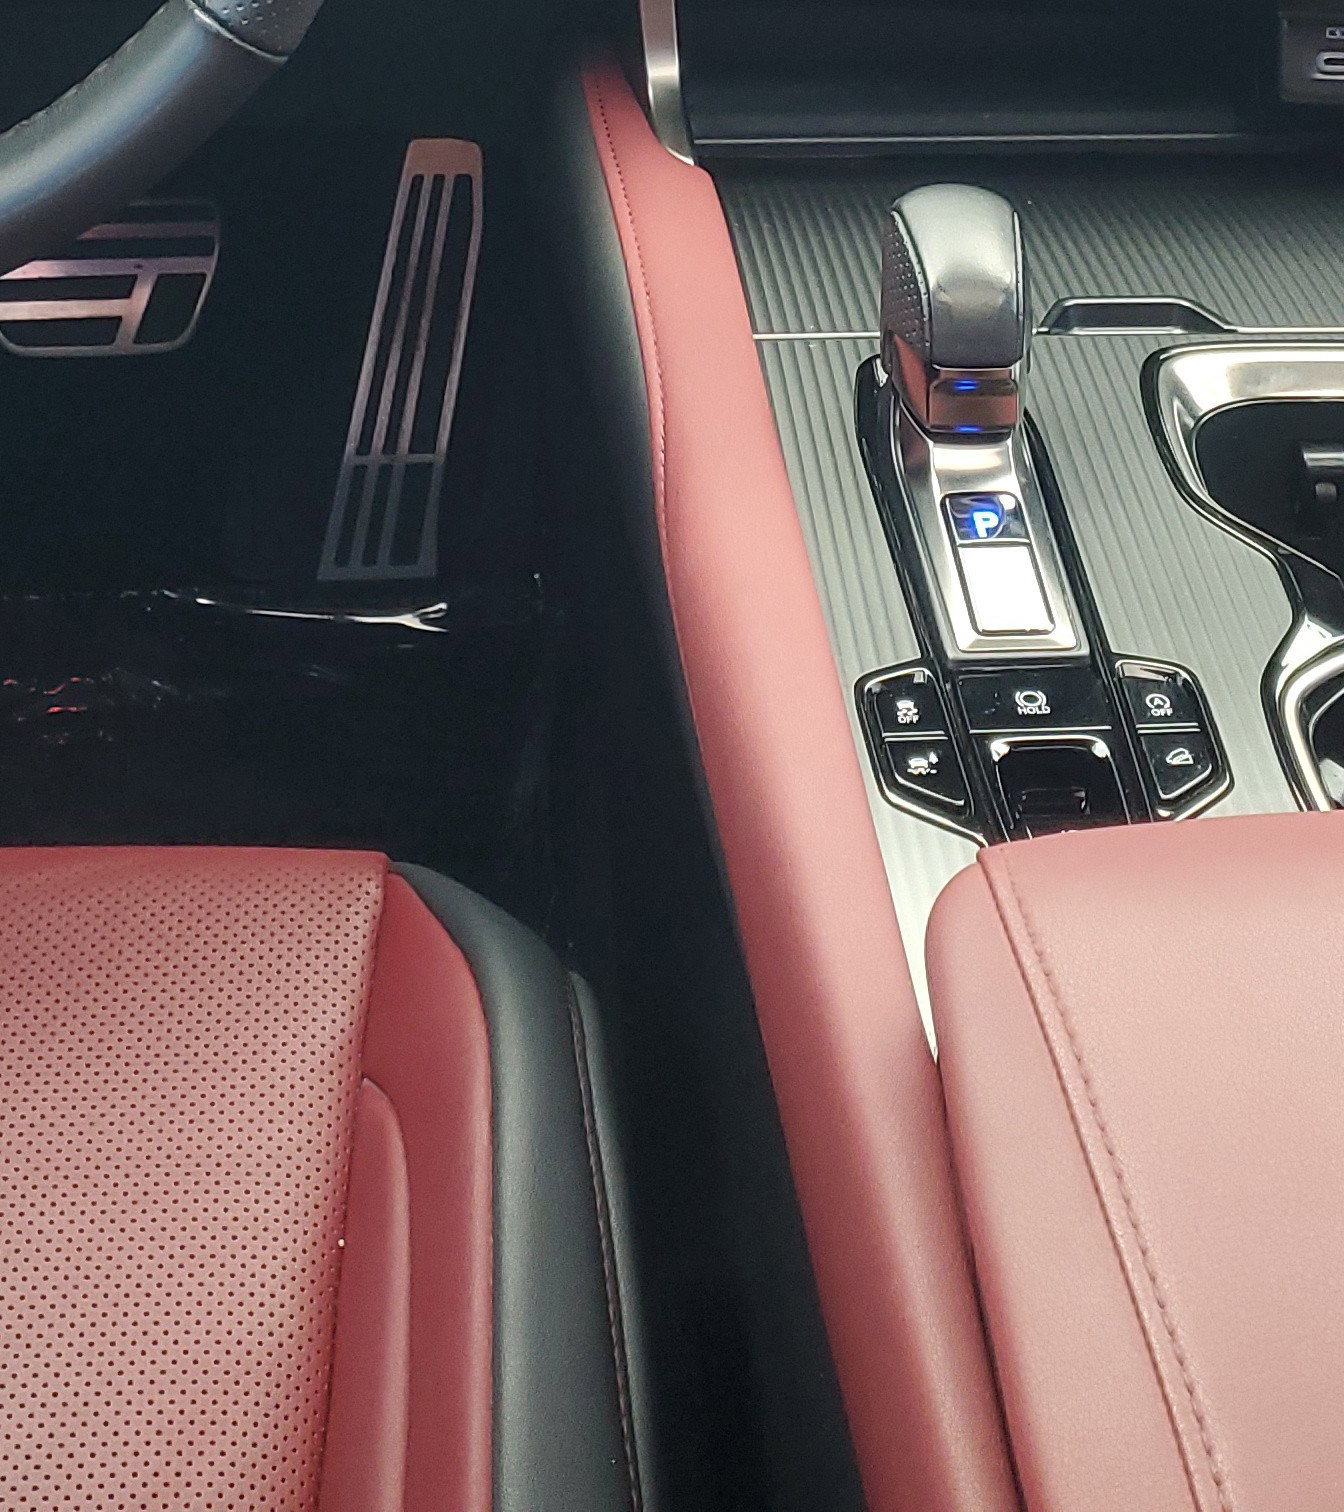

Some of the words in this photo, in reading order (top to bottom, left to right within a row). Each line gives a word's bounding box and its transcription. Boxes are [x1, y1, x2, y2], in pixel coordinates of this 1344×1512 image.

[972, 511, 999, 538] P
[1017, 705, 1051, 715] HOLD
[1150, 707, 1173, 717] OFF
[897, 715, 919, 725] OFF
